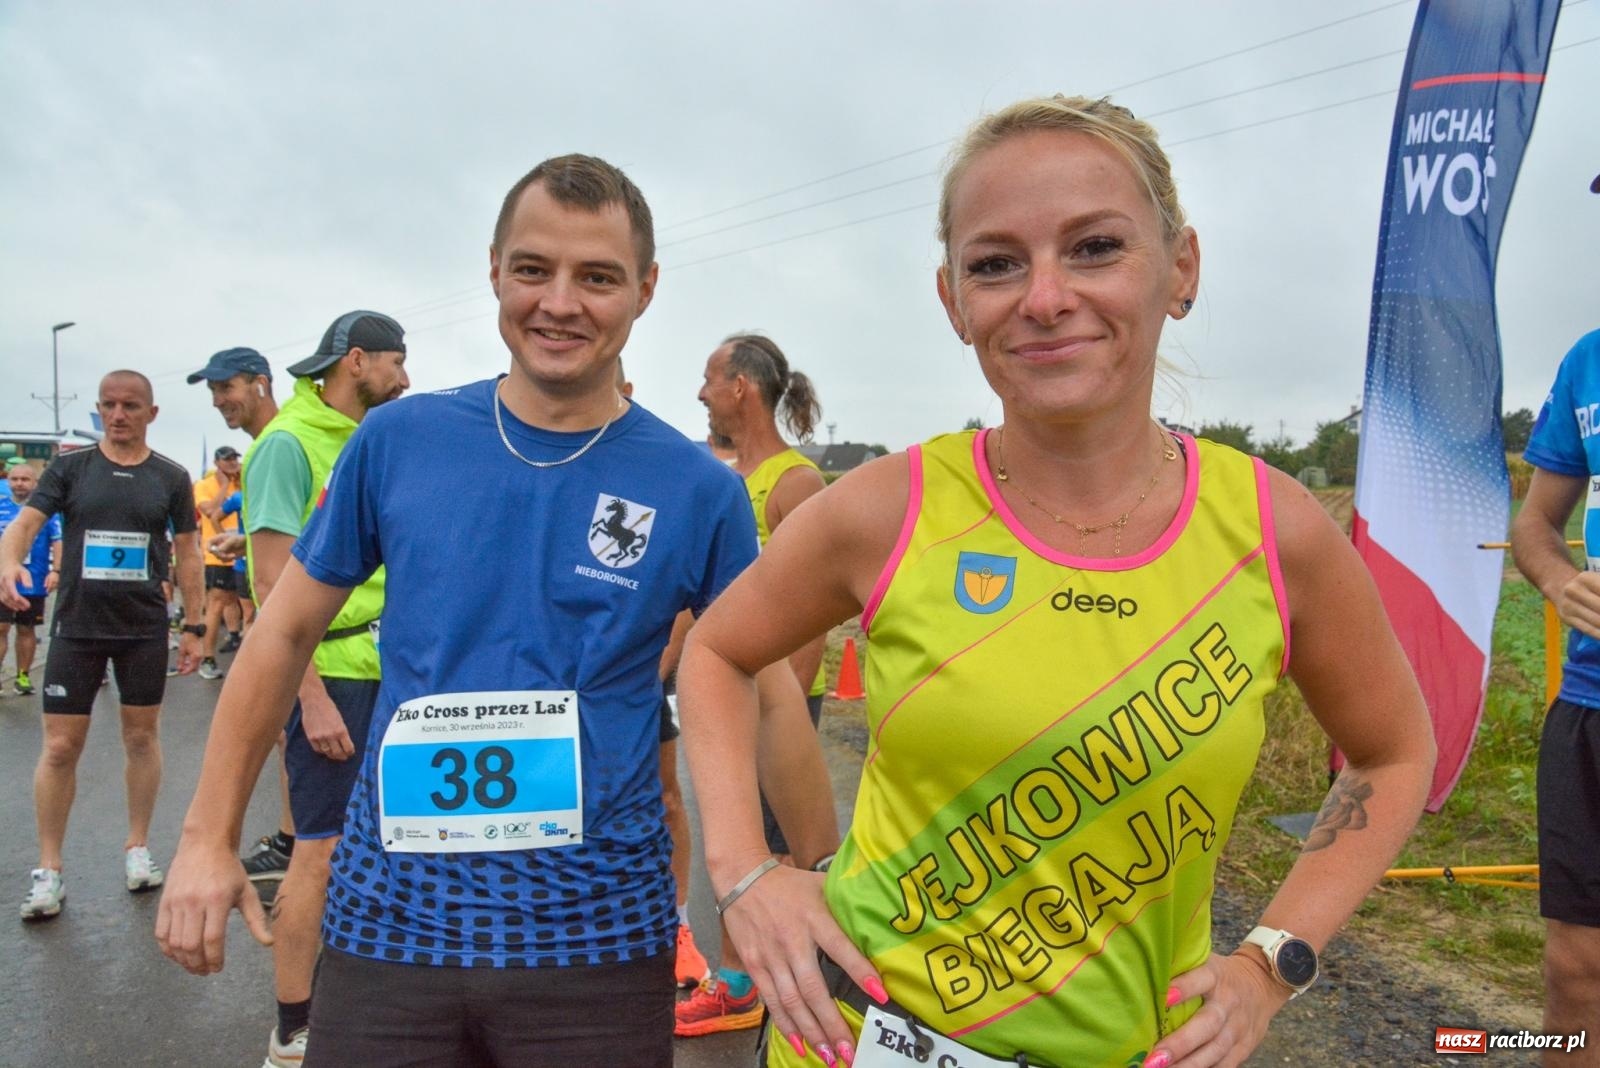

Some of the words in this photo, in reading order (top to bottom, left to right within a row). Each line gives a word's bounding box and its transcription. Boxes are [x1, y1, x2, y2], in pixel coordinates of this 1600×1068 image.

[111, 548, 126, 568] 9
[574, 564, 640, 591] NIEBOROWICE
[1050, 587, 1138, 619] deep
[396, 708, 419, 723] Eko
[424, 705, 469, 719] Cross
[475, 703, 529, 719] przez
[535, 700, 566, 715] Las
[450, 724, 459, 732] 30
[460, 722, 496, 732] września
[497, 721, 519, 730] 2023
[430, 746, 517, 811] 38
[890, 622, 1252, 934] JEJKOWICE
[924, 785, 1216, 1014] BIEGAJĄ
